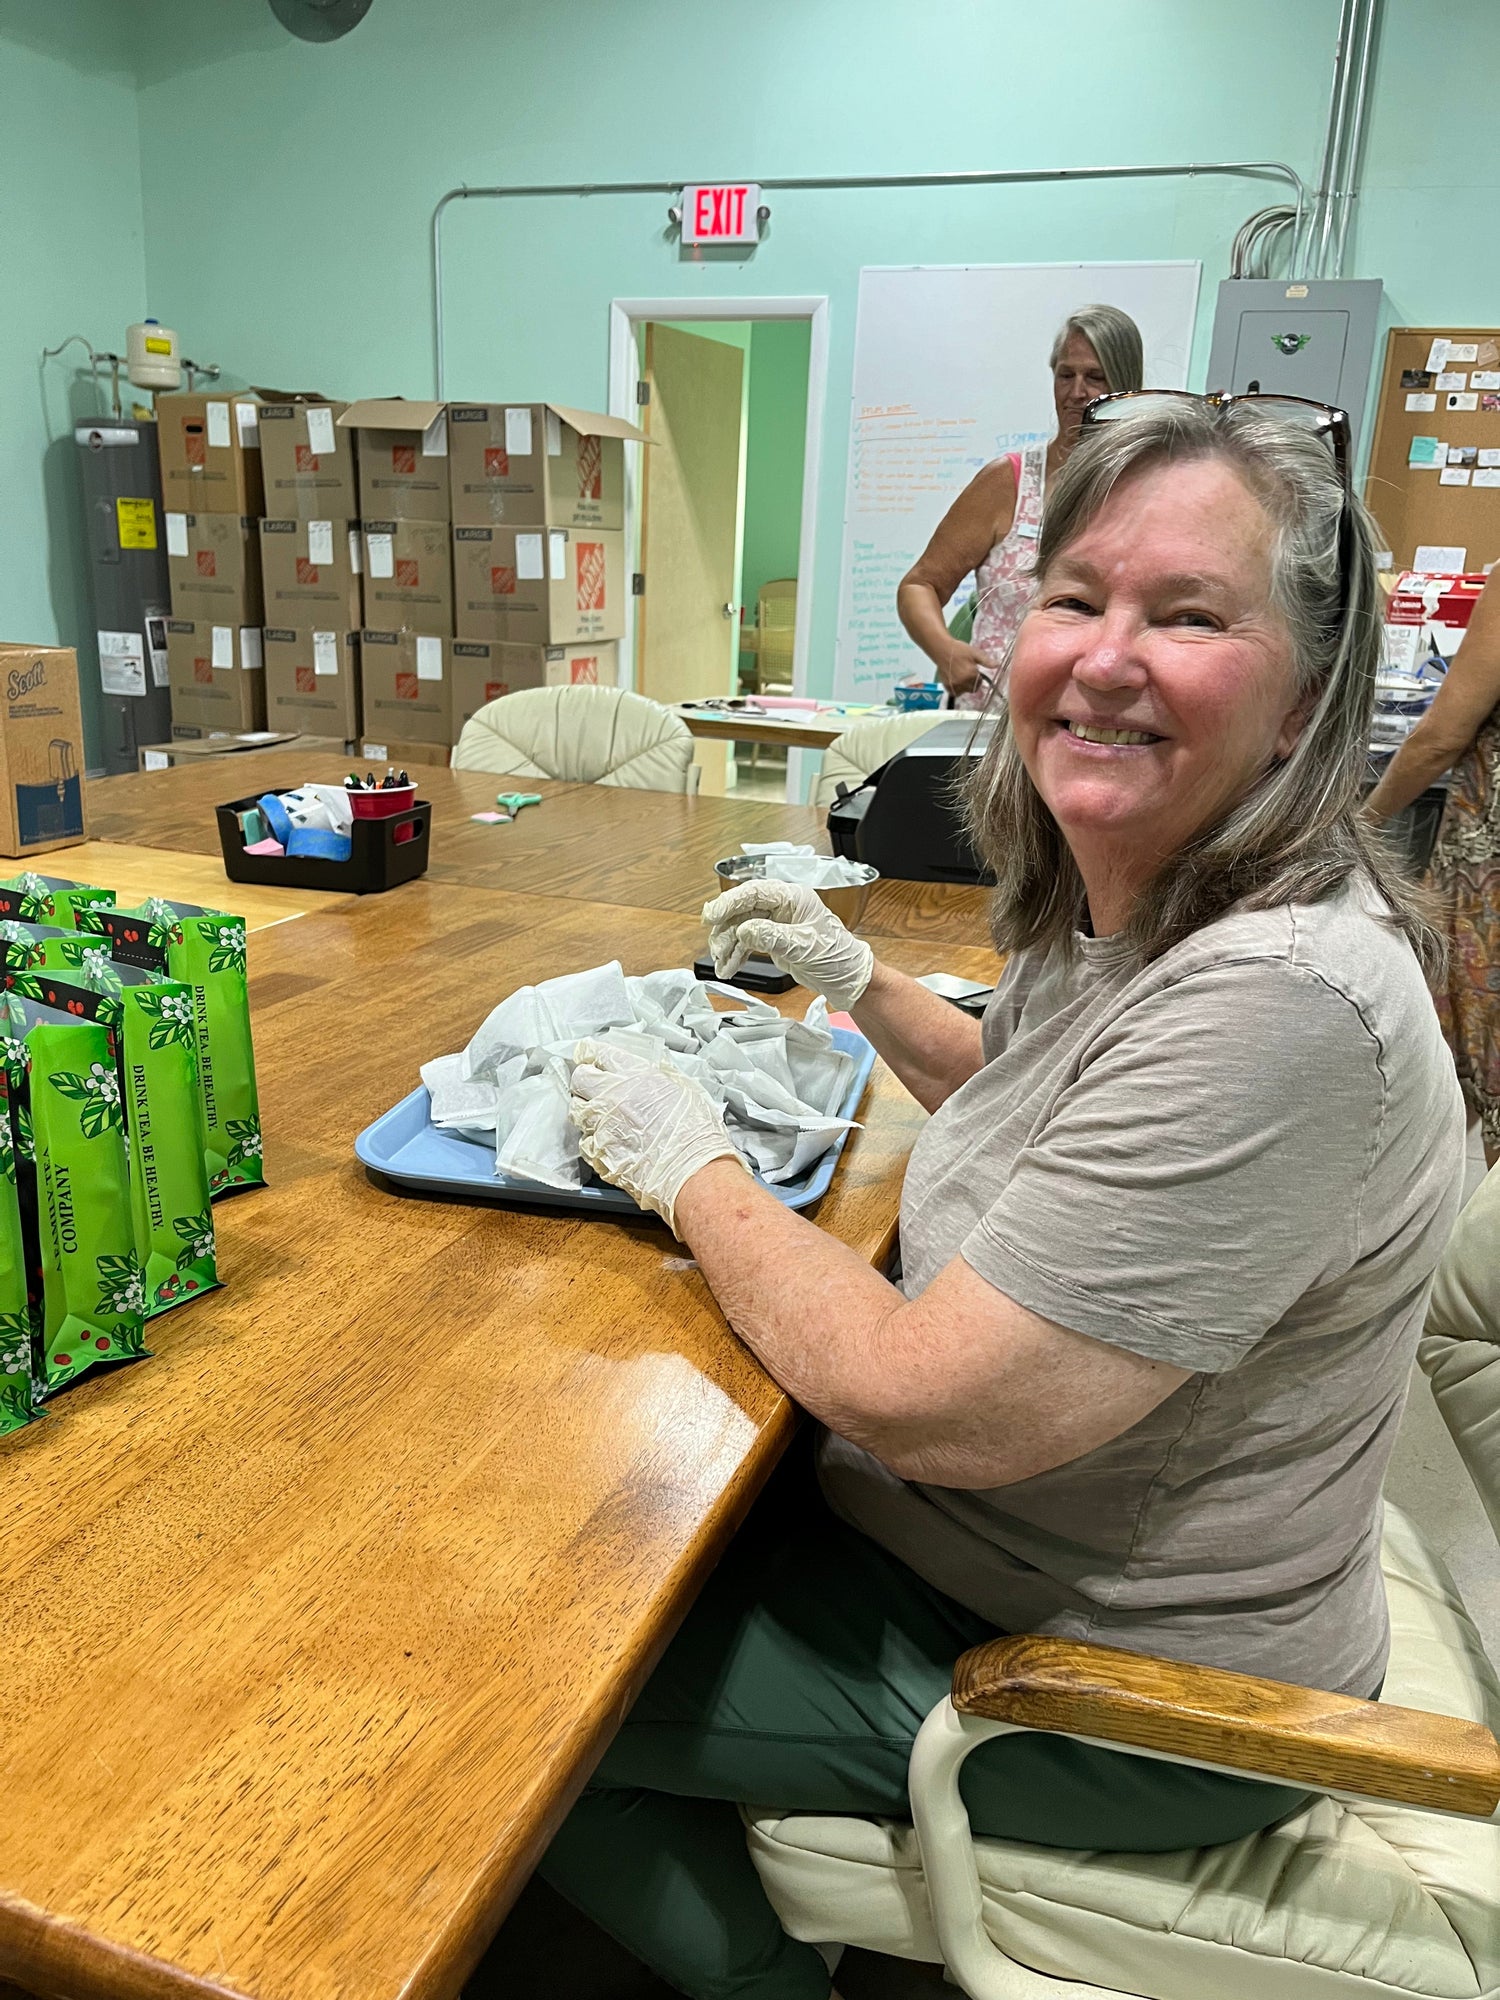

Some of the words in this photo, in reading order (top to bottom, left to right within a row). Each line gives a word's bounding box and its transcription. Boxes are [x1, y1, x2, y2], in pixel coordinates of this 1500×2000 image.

[695, 188, 748, 236] EXIT
[453, 410, 486, 420] LARGE
[458, 529, 489, 539] LARGE
[7, 660, 45, 701] Scott
[195, 985, 208, 1024] DRINK
[199, 1027, 211, 1053] TEA.
[202, 1056, 213, 1072] BE
[133, 1065, 150, 1108] DRINK
[204, 1075, 219, 1132] HEALTHY.
[138, 1111, 151, 1142] TEA.
[142, 1145, 154, 1163] BE
[55, 1163, 78, 1254] COMPANY
[145, 1166, 164, 1232] HEALTHY.
